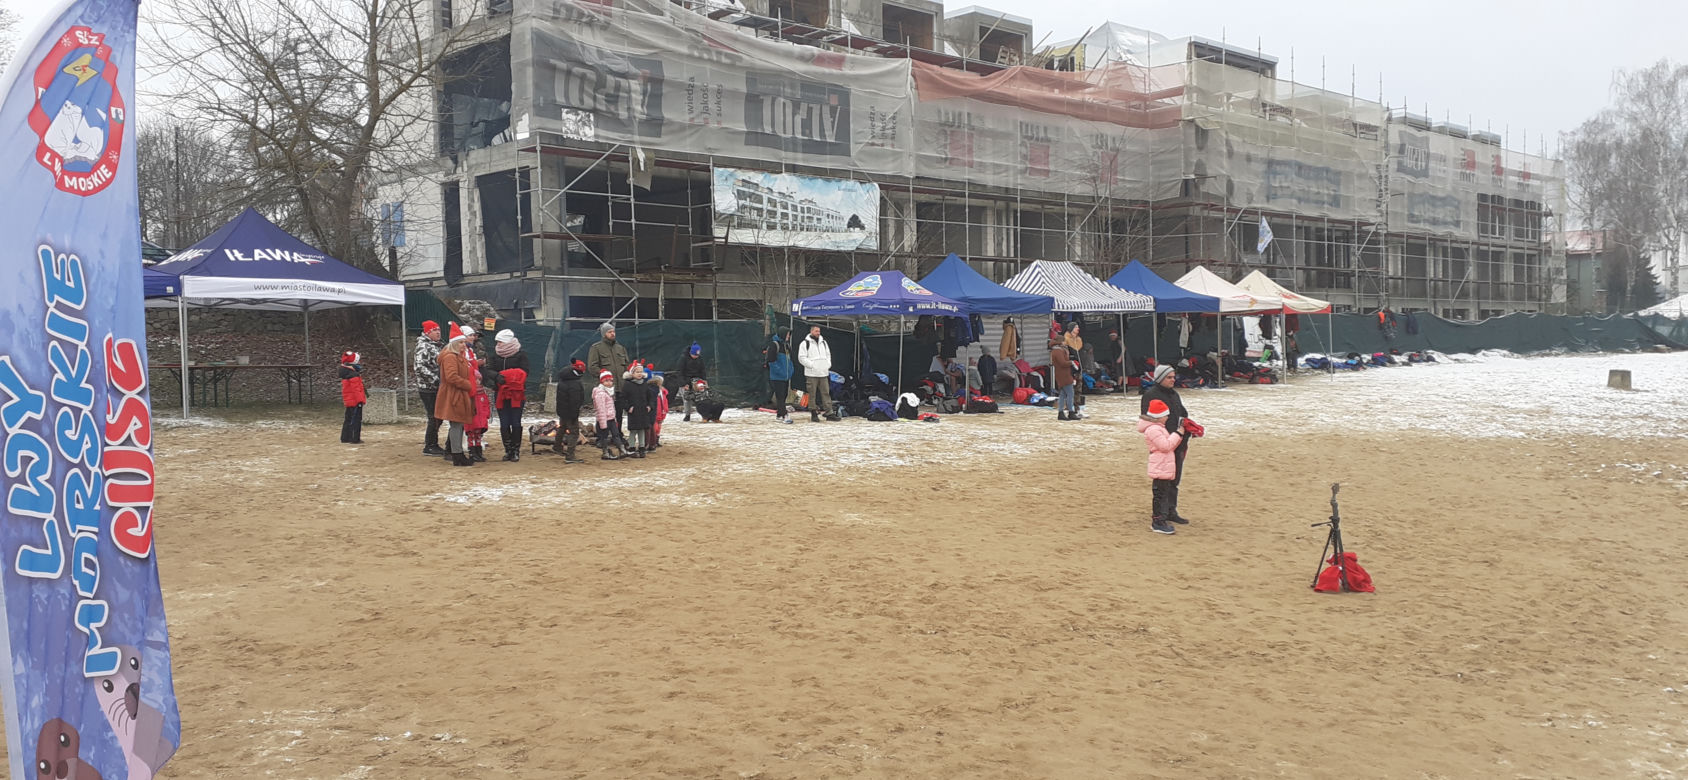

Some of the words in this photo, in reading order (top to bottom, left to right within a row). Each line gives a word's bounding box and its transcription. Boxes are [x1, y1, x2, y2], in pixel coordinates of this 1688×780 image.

[685, 76, 695, 114] wiedza
[64, 164, 112, 191] MOSKIE
[224, 248, 310, 265] IŁAWA
[0, 355, 64, 579] LWY
[38, 244, 122, 678] MORSKIE
